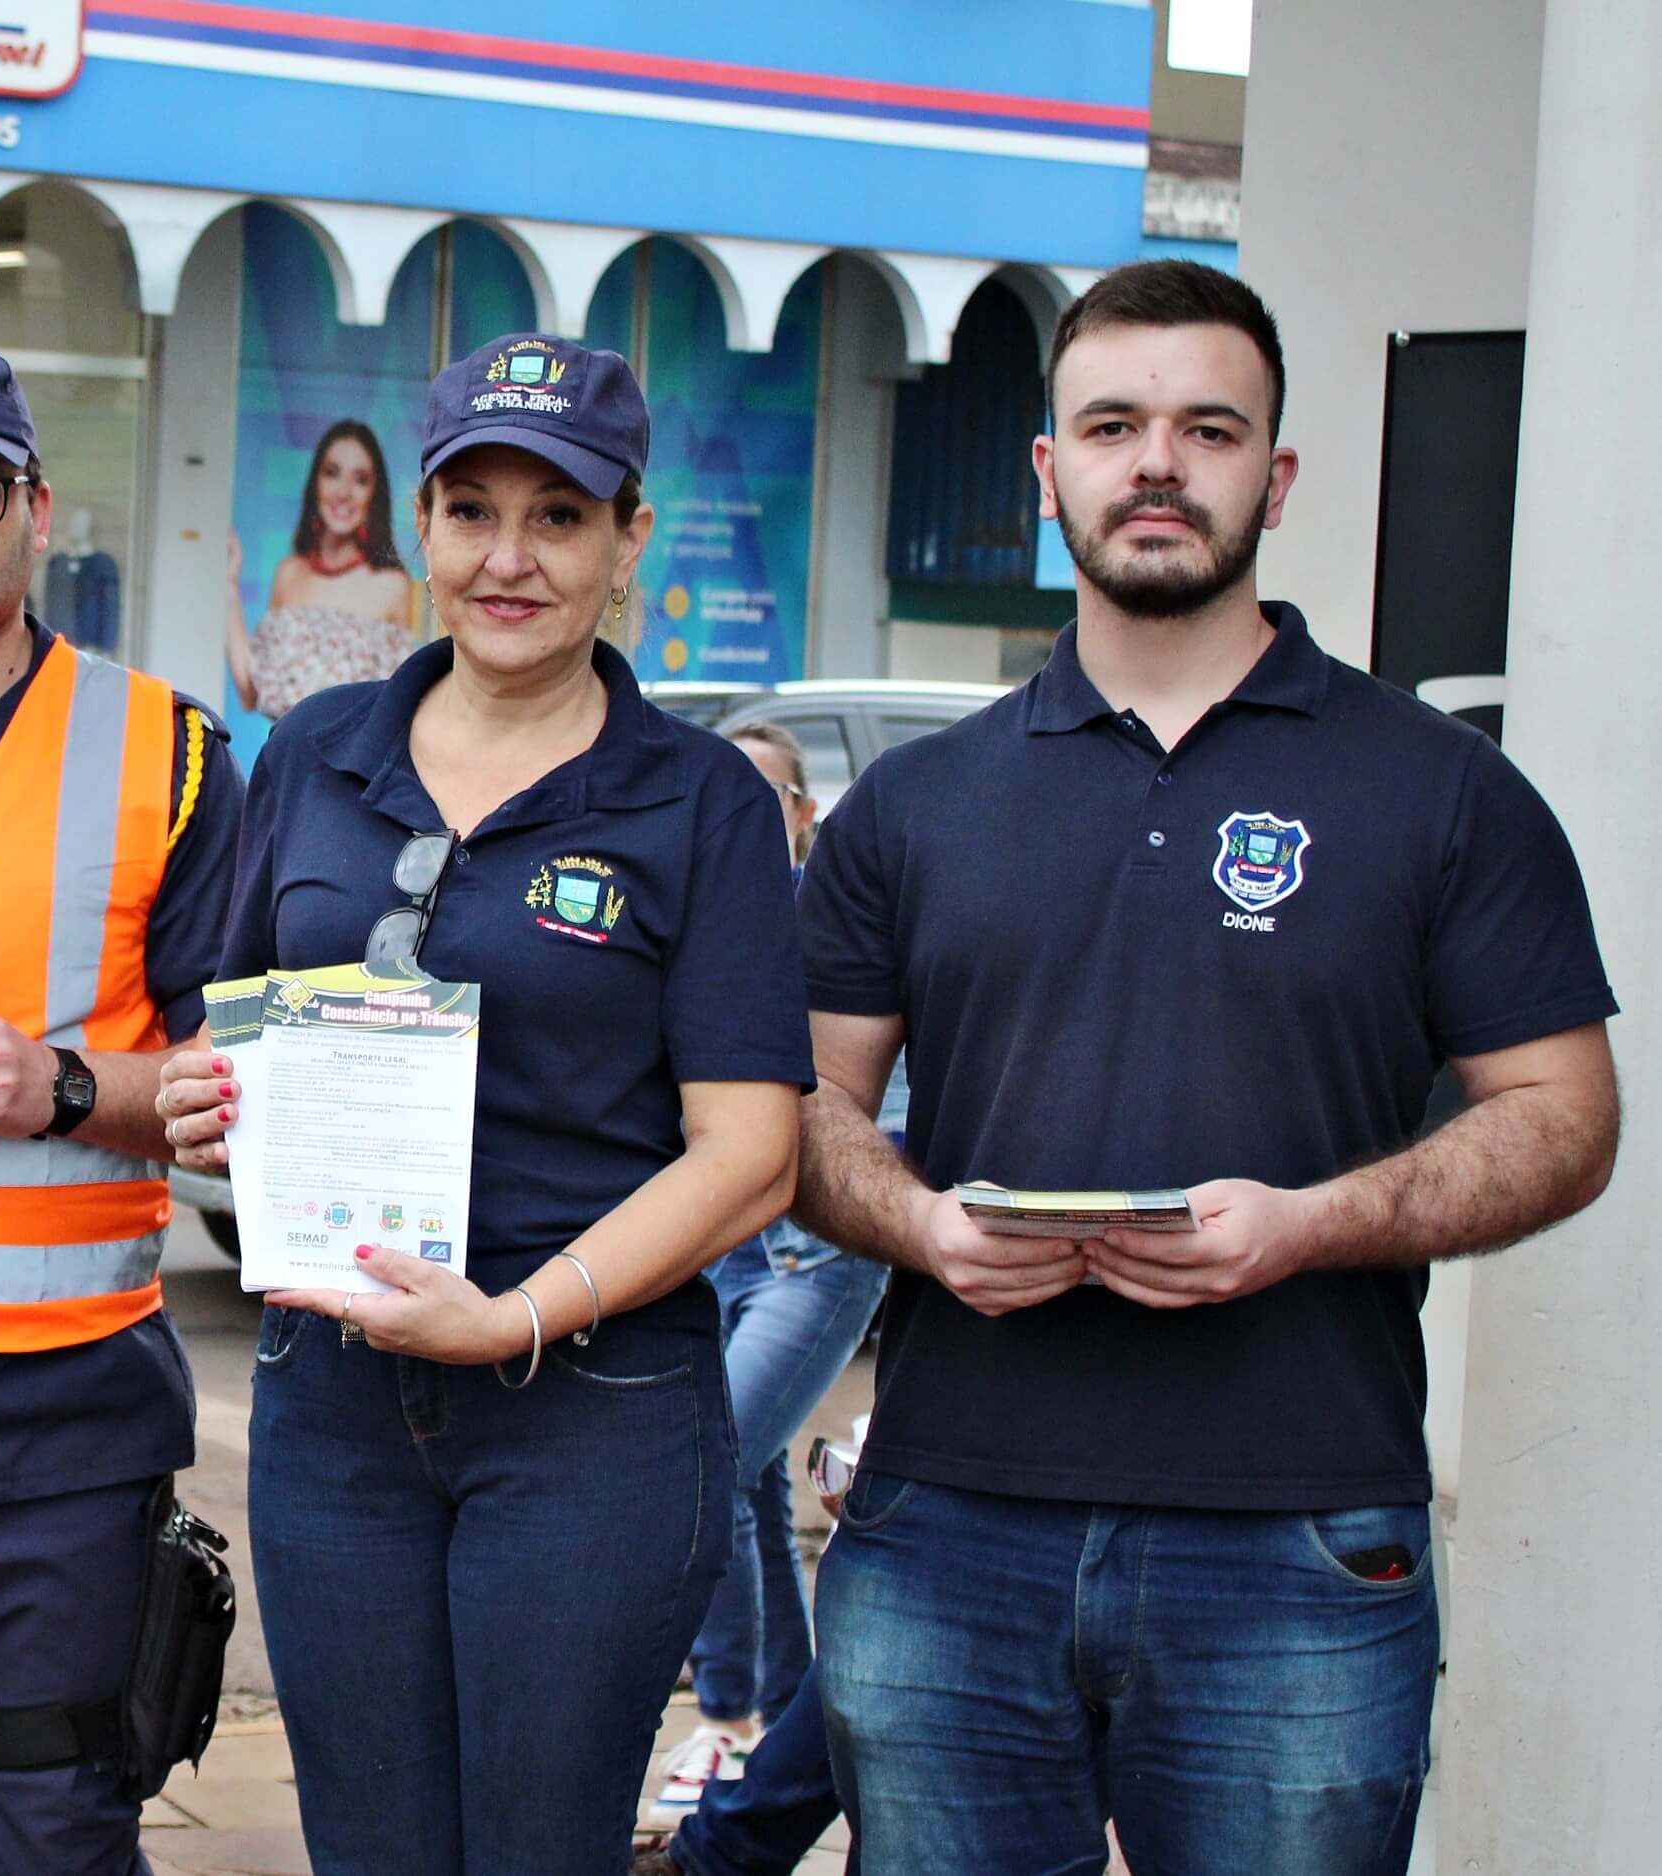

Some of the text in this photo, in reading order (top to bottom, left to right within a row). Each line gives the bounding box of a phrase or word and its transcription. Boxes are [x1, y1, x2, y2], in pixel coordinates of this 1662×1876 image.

[471, 392, 571, 408] AGENTE FISCAL
[1222, 911, 1276, 932] DIONE
[363, 989, 431, 1009] Campanha
[320, 1003, 472, 1028] Consciência no Trânsito
[286, 1231, 329, 1245] SEMAD
